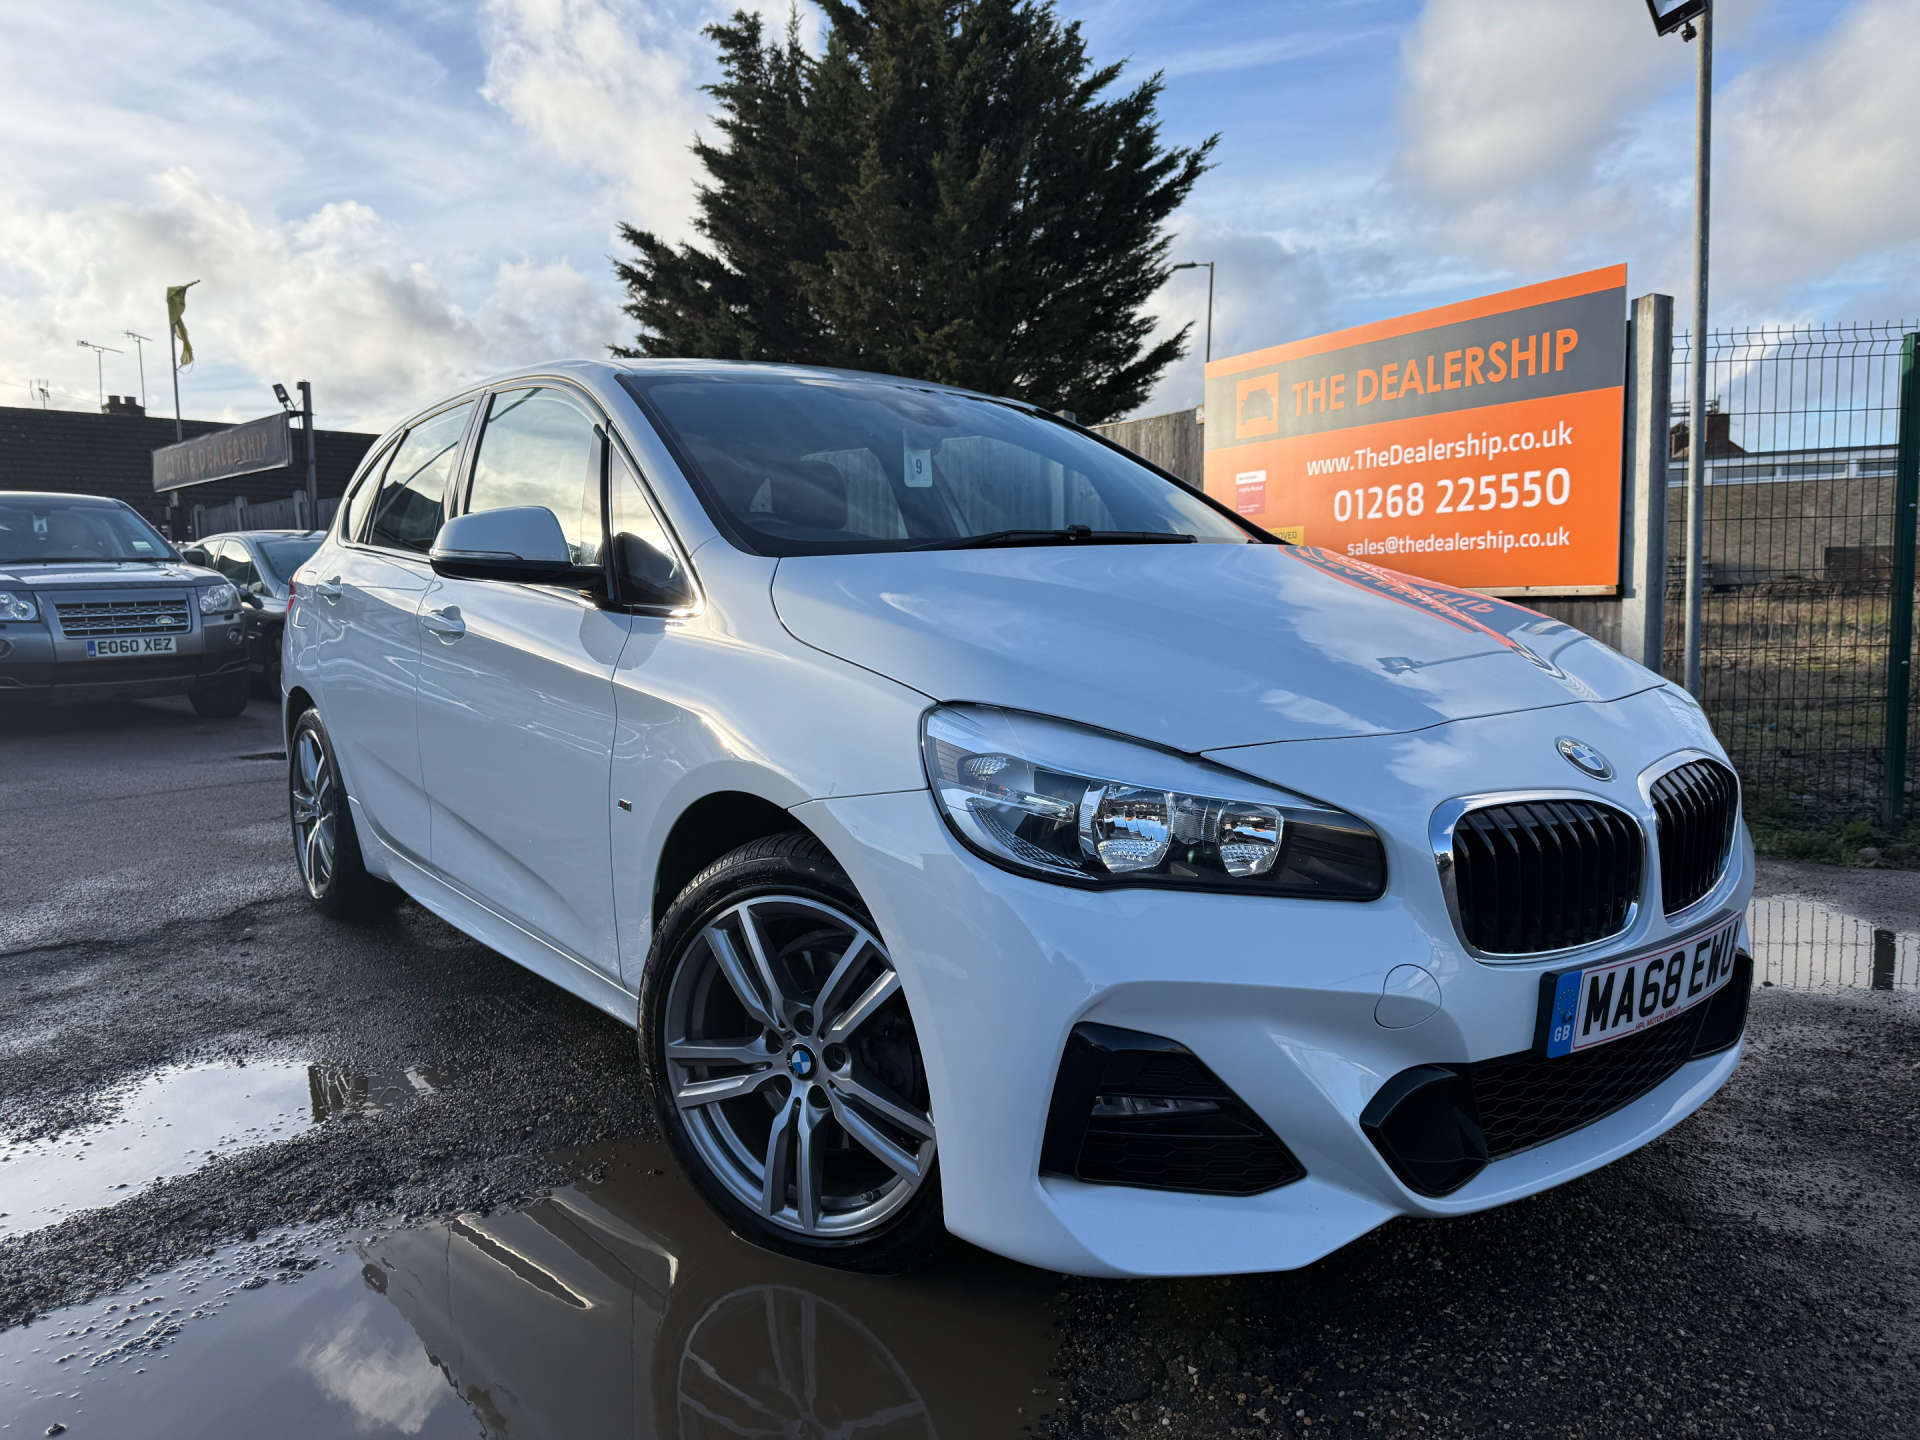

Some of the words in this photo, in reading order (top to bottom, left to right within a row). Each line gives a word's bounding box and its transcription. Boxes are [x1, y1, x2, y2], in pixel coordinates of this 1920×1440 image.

[1292, 374, 1346, 417] THE
[1356, 328, 1579, 408] DEALERSHIP
[915, 459, 922, 474] 9
[1306, 421, 1573, 476] www.TheDealership.co.uk
[1333, 482, 1425, 522] 01268
[1435, 467, 1571, 514] 225550
[1347, 526, 1571, 557] sales@thedealership.co.uk
[143, 638, 173, 652] XEZ
[1582, 950, 1685, 1036] MA68
[1687, 919, 1740, 998] EWU
[1554, 1024, 1570, 1043] GB
